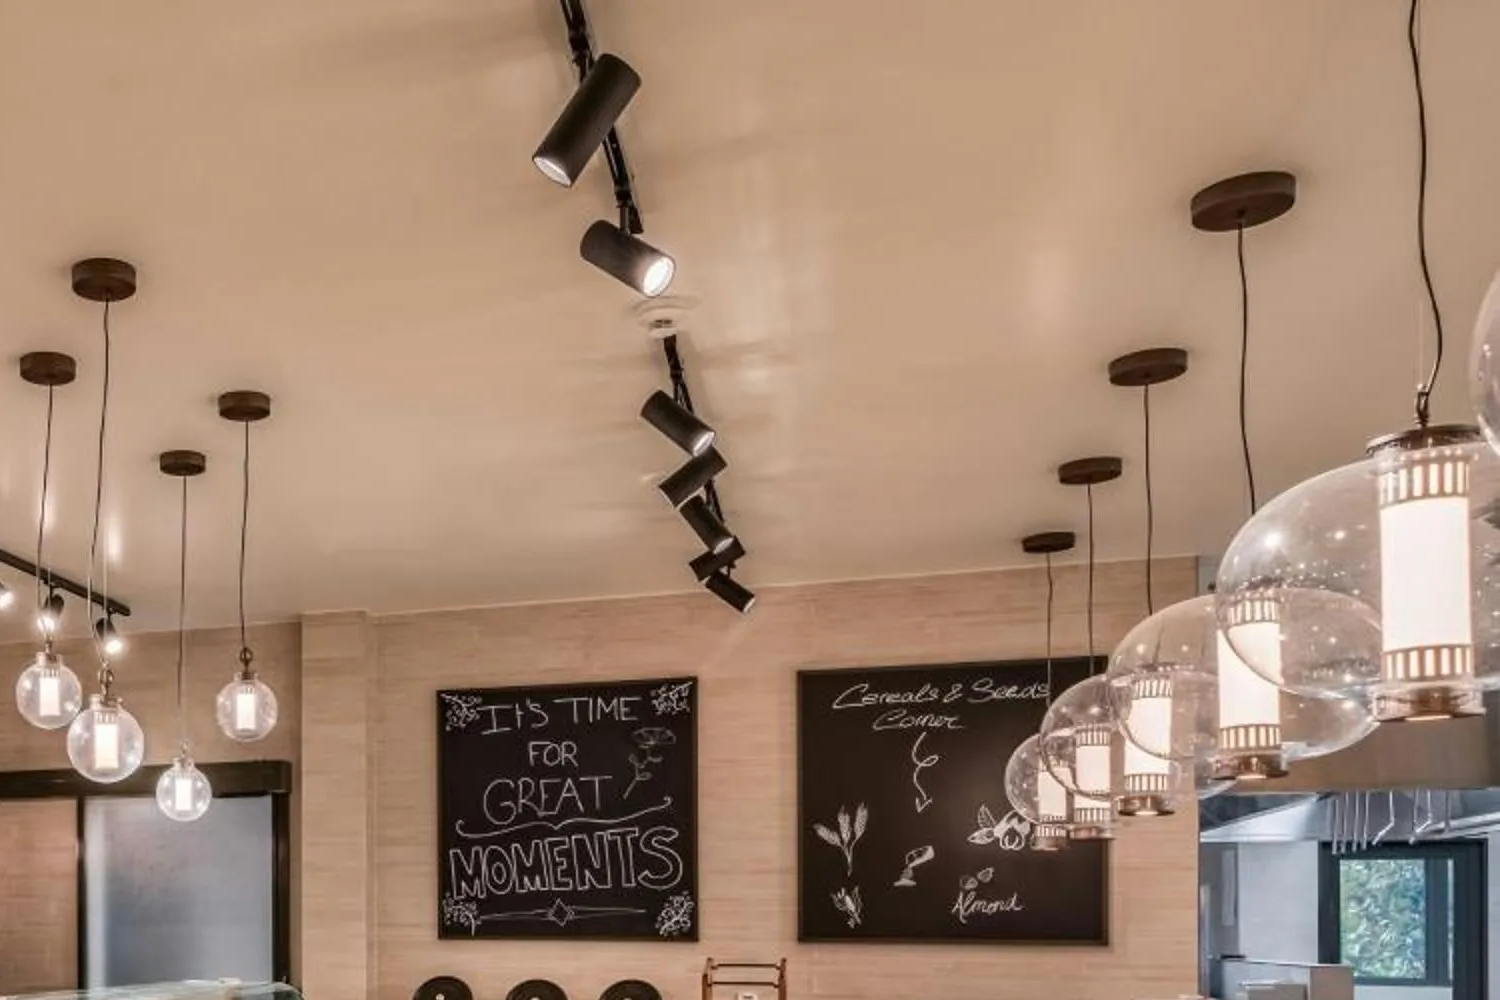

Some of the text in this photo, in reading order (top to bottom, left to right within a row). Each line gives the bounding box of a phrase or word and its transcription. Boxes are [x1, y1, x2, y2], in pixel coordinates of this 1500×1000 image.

[552, 694, 642, 725] TIME
[832, 683, 938, 710] Cereals
[967, 677, 1050, 704] Seeds
[872, 707, 966, 731] Corner
[527, 740, 579, 767] FOR
[483, 775, 612, 825] GREAT
[449, 826, 683, 900] MOMENTS
[951, 890, 1027, 924] Almond
